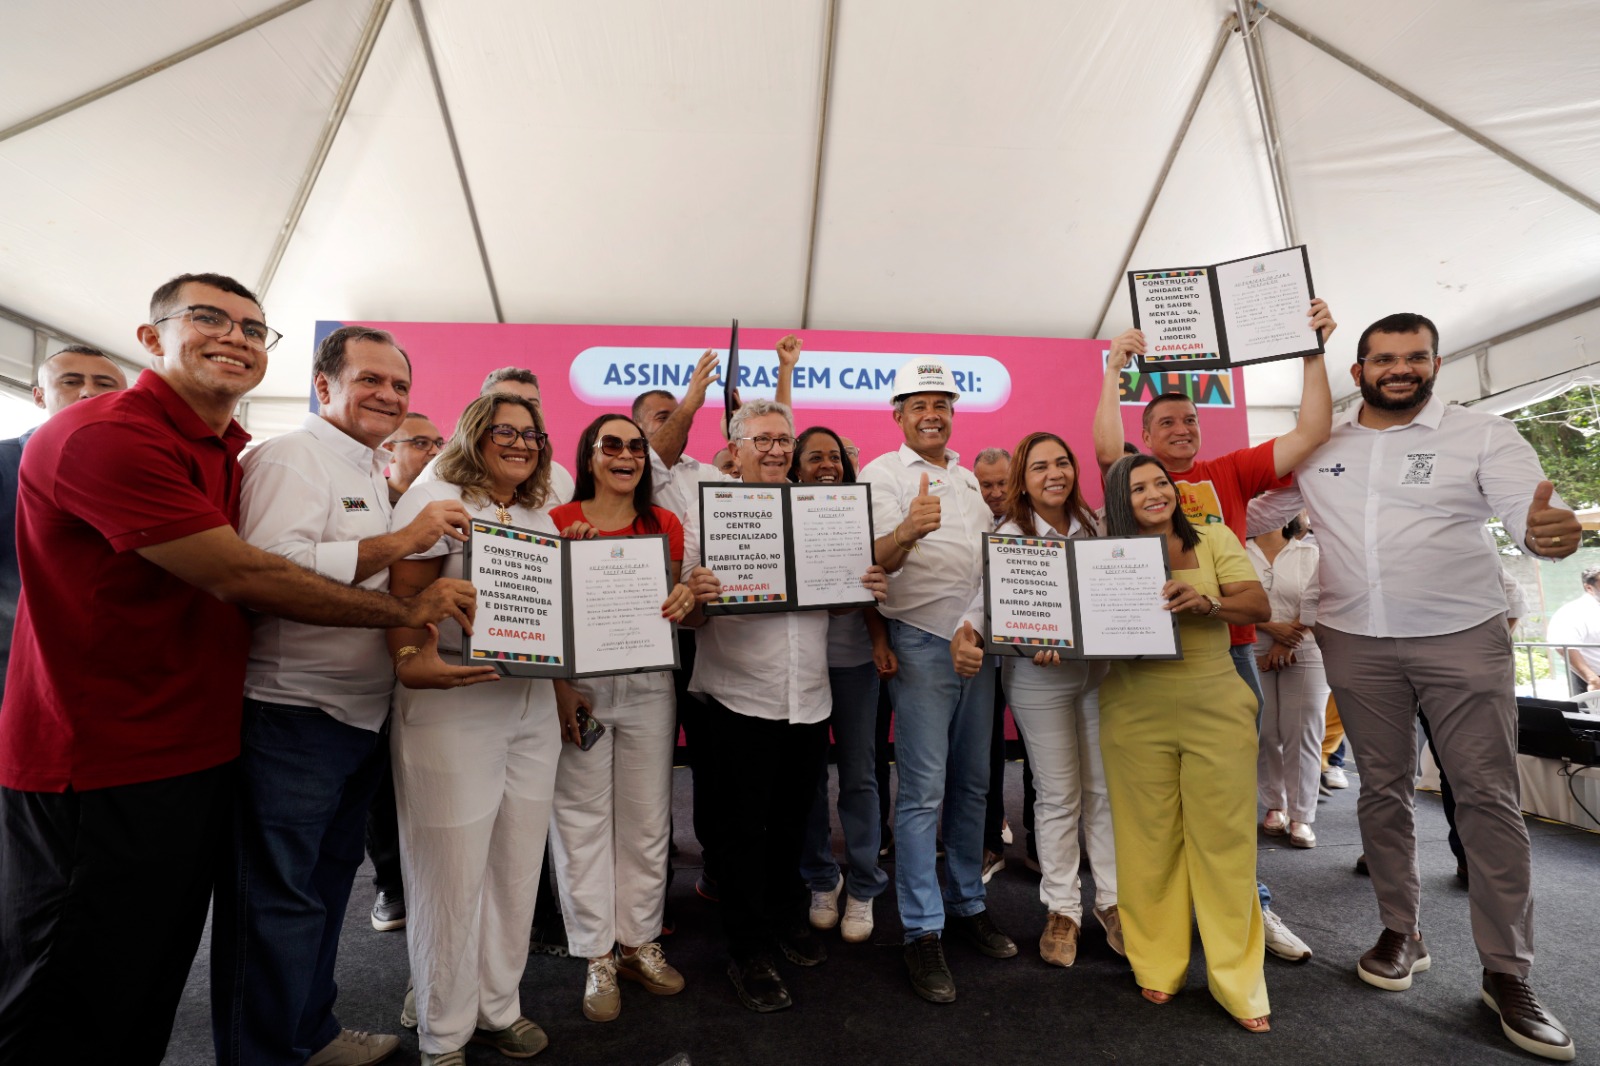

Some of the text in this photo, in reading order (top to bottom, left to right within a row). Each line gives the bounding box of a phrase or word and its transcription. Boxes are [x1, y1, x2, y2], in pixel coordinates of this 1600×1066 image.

[1142, 277, 1198, 286] CONSTRUÇÃO
[1149, 286, 1182, 294] UNIDADE
[1145, 293, 1200, 302] ACOLHIMENTO
[1155, 343, 1204, 352] CAMAÇARI
[603, 363, 981, 392] ASSINAURAS EM CAMRI:
[713, 510, 772, 519] CONSTRUÇÃO
[483, 545, 549, 564] CONSTRUÇÃO
[708, 552, 769, 562] REABILITAÇÃO,
[997, 546, 1058, 559] CONSTRUÇÃO
[491, 558, 542, 573] 03 UBS NOS
[712, 562, 742, 571] ÂMBITO
[479, 567, 552, 585] BAIRROS JARDIM
[494, 580, 539, 594] LIMOEIRO,
[1001, 578, 1058, 587] PSICOSSOCIAL
[722, 584, 770, 592] CAMAÇARI
[1013, 588, 1034, 596] CAPS
[480, 590, 552, 605] MASSARANDUBA
[1000, 599, 1029, 607] BAIRRO
[494, 603, 535, 614] DISTRITO
[537, 608, 548, 616] DE
[1012, 609, 1051, 618] LIMOEIRO
[494, 614, 541, 626] ABRANTES
[1006, 621, 1058, 632] CAMAÇARI
[488, 627, 545, 641] CAMAÇARI
